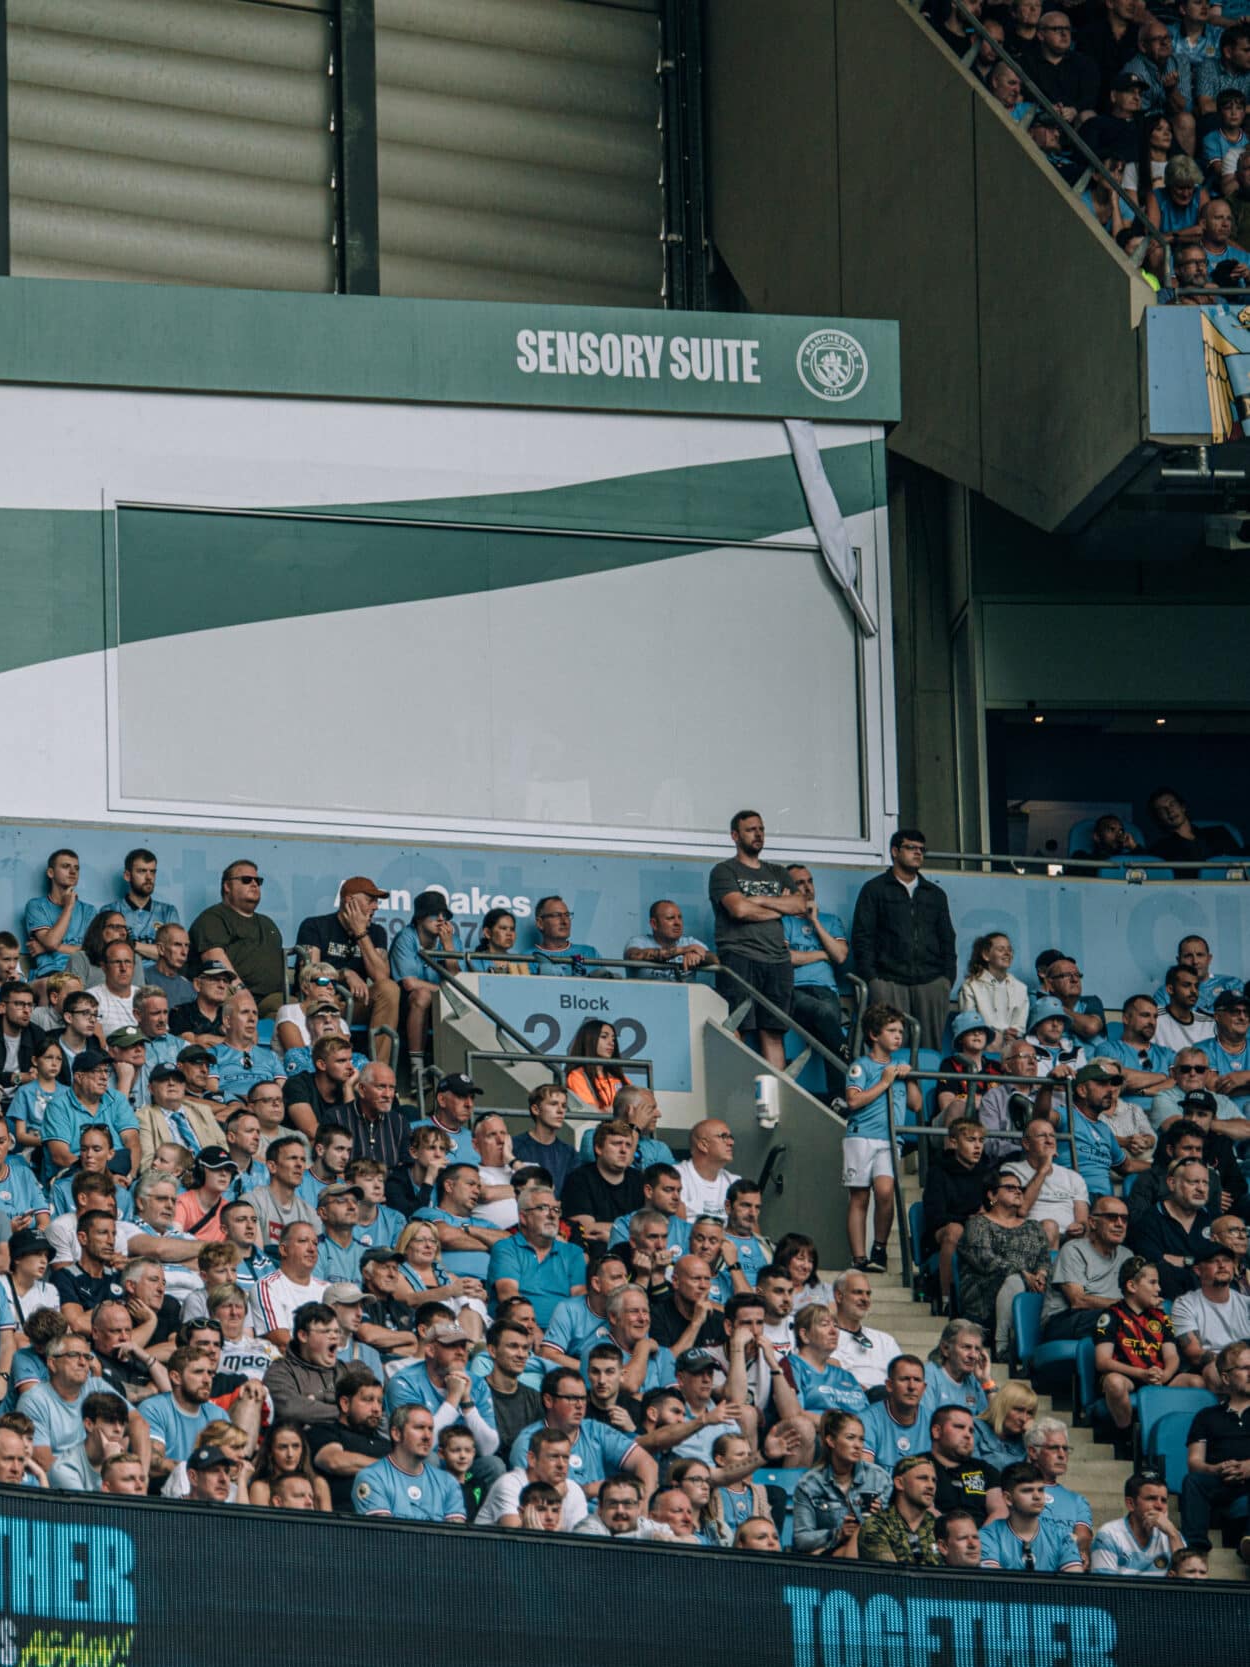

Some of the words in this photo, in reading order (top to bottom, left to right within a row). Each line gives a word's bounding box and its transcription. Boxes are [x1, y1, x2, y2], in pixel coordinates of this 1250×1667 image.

[516, 328, 664, 379] SENSORY
[669, 335, 762, 384] SUITE
[804, 335, 859, 358] MANCHESTER
[823, 388, 845, 396] CITY
[559, 994, 610, 1011] Block
[523, 1013, 648, 1074] 22
